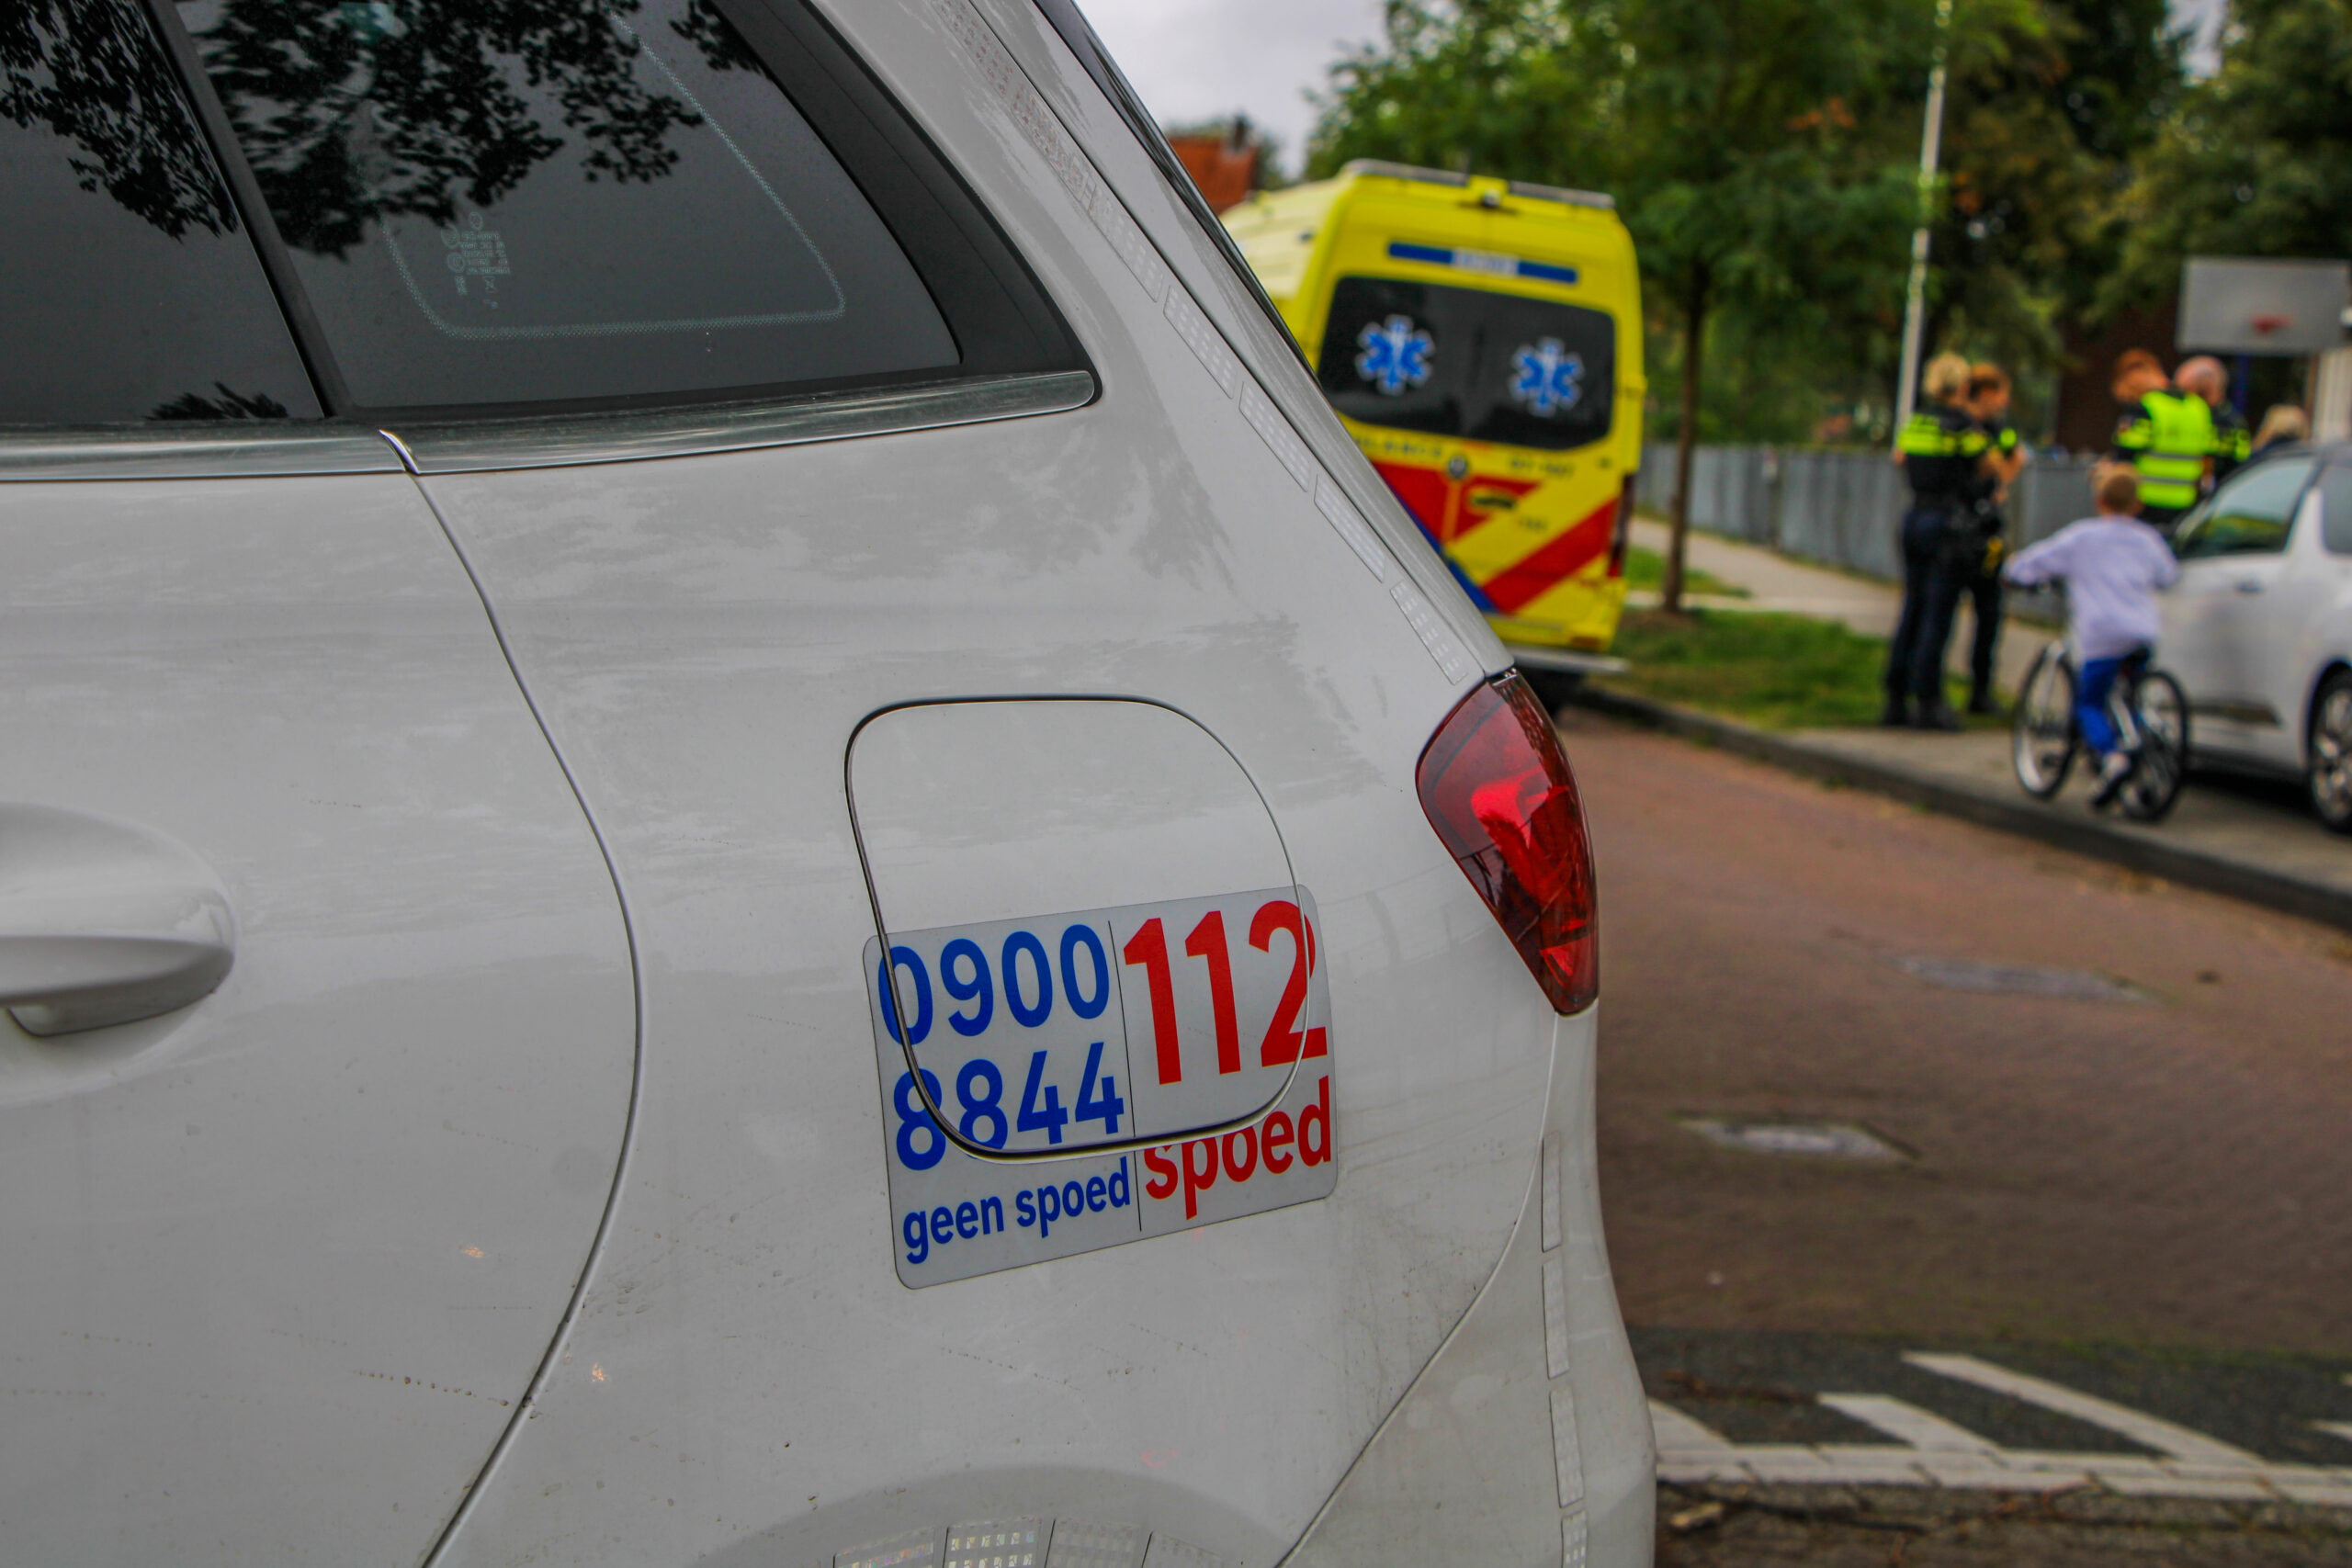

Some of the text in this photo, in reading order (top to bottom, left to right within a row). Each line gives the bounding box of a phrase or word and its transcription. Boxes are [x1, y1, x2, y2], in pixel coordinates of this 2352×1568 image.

[878, 924, 1110, 1045] 0900
[1123, 900, 1328, 1086] 112
[894, 1042, 1125, 1171] 8844
[1144, 1075, 1331, 1221] spoed
[903, 1156, 1131, 1265] geen spoed
